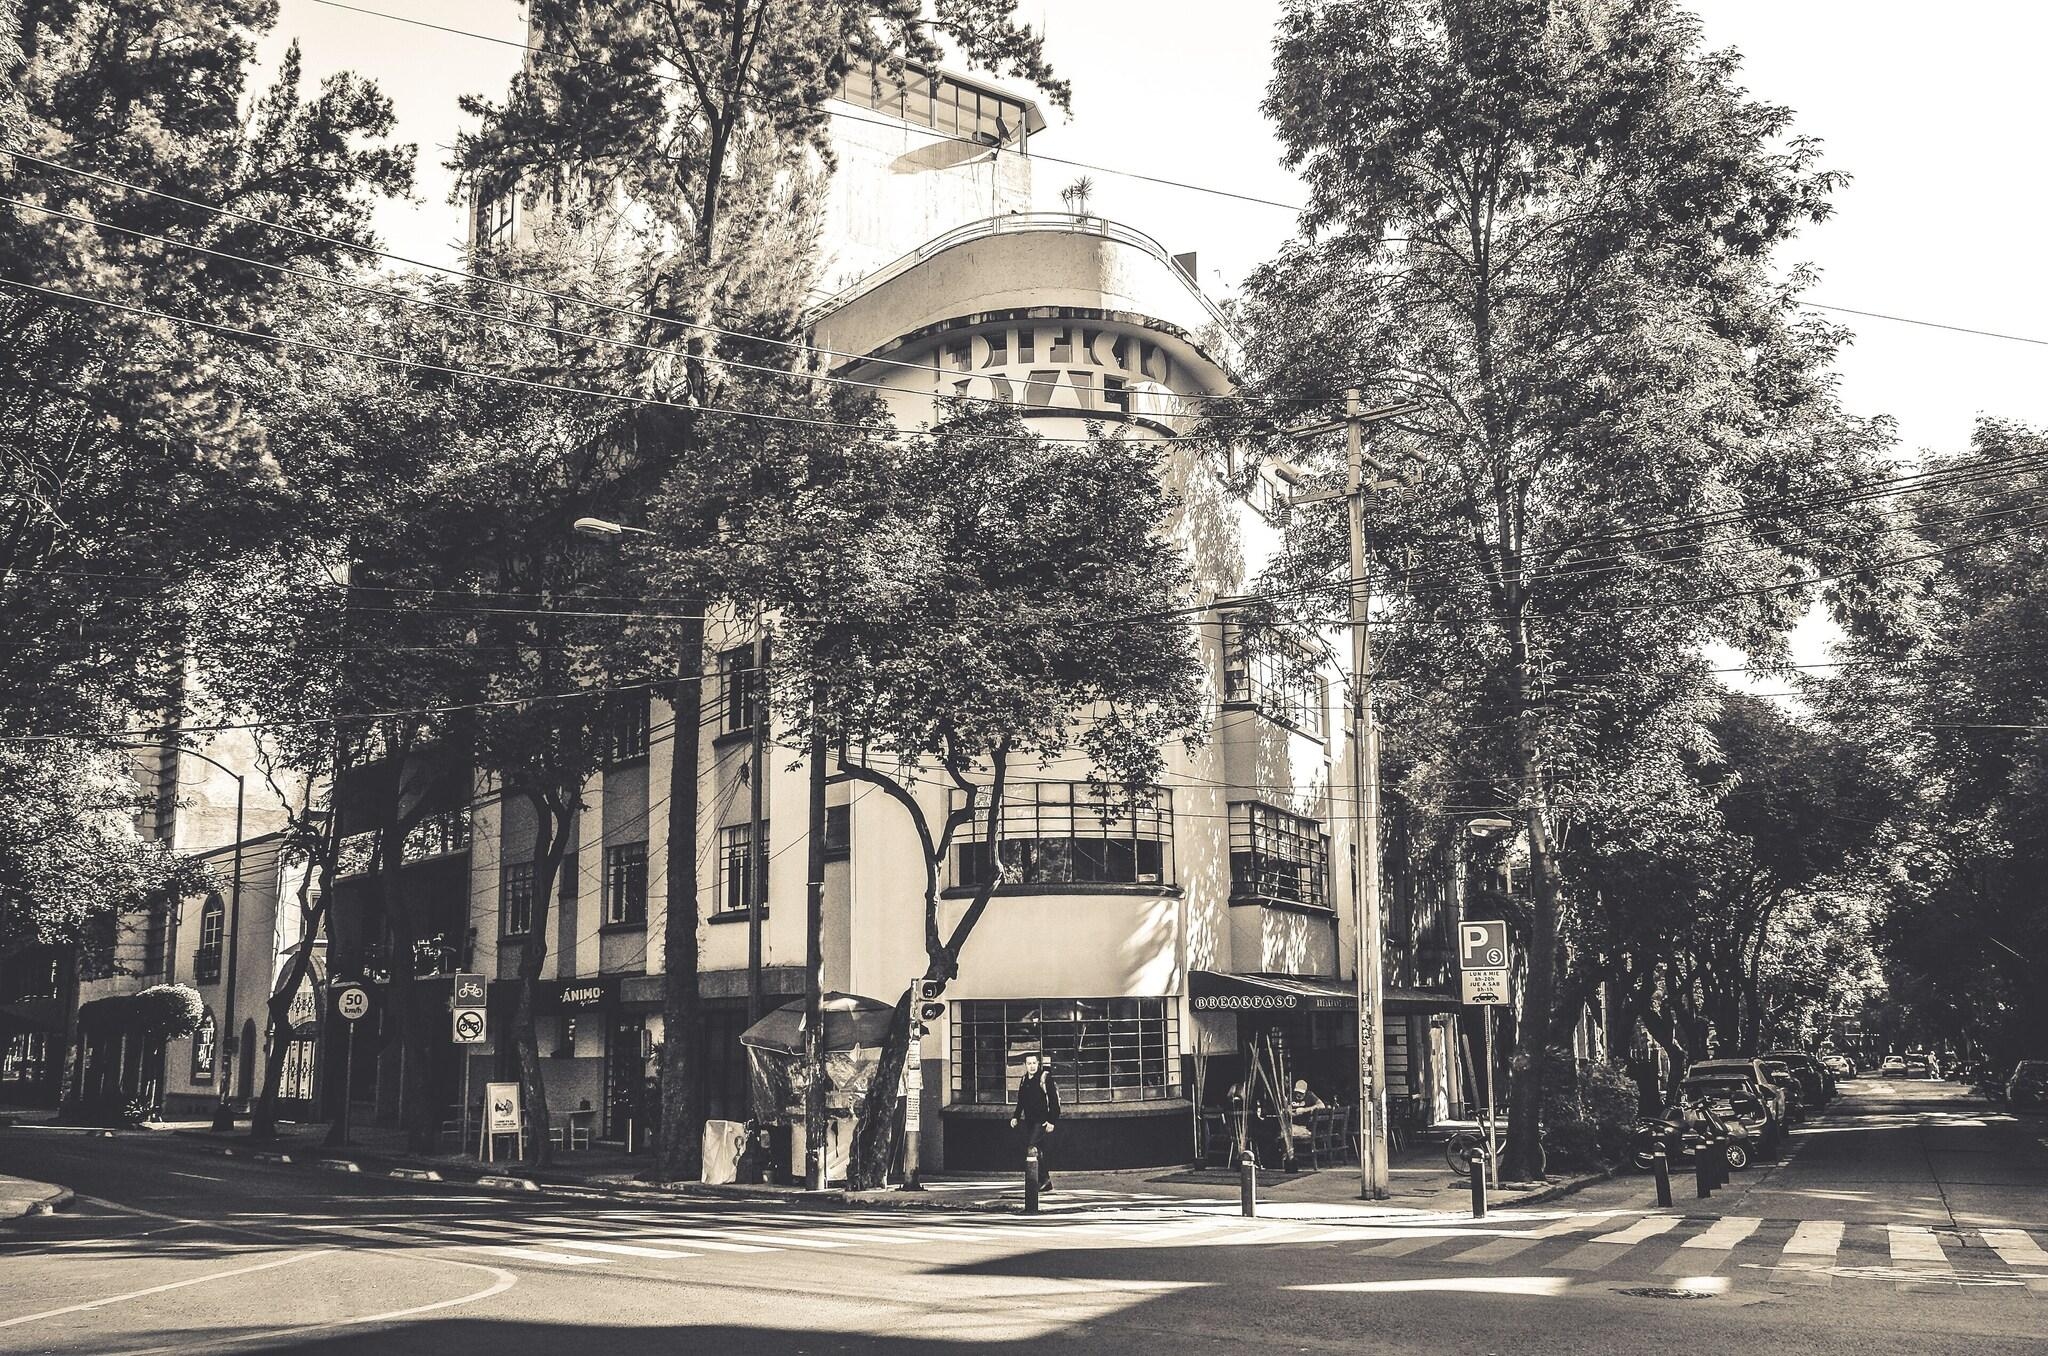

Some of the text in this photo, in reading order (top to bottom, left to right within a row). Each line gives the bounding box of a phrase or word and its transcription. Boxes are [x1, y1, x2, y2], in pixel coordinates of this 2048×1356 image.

[1463, 926, 1488, 959] P
[346, 994, 362, 1005] 50
[1195, 994, 1297, 1009] BREAKFAST
[344, 1006, 362, 1014] km/h
